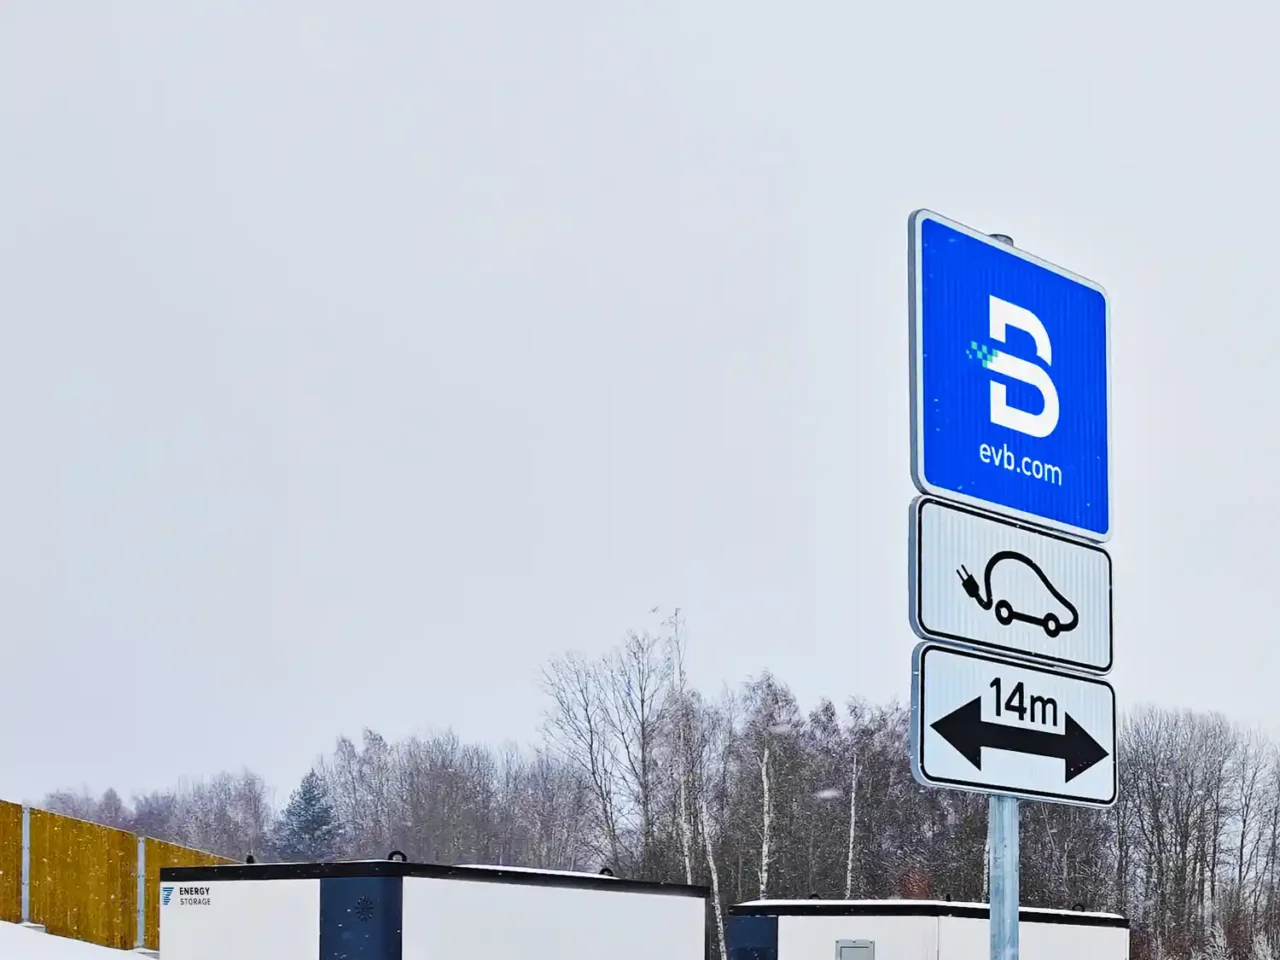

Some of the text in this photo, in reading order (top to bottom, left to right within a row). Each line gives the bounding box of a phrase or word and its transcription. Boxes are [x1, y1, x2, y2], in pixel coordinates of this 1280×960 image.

[979, 442, 1063, 486] evb.com
[989, 677, 1058, 727] 14m
[179, 886, 210, 896] ENERGY
[180, 897, 211, 906] STORAGE
